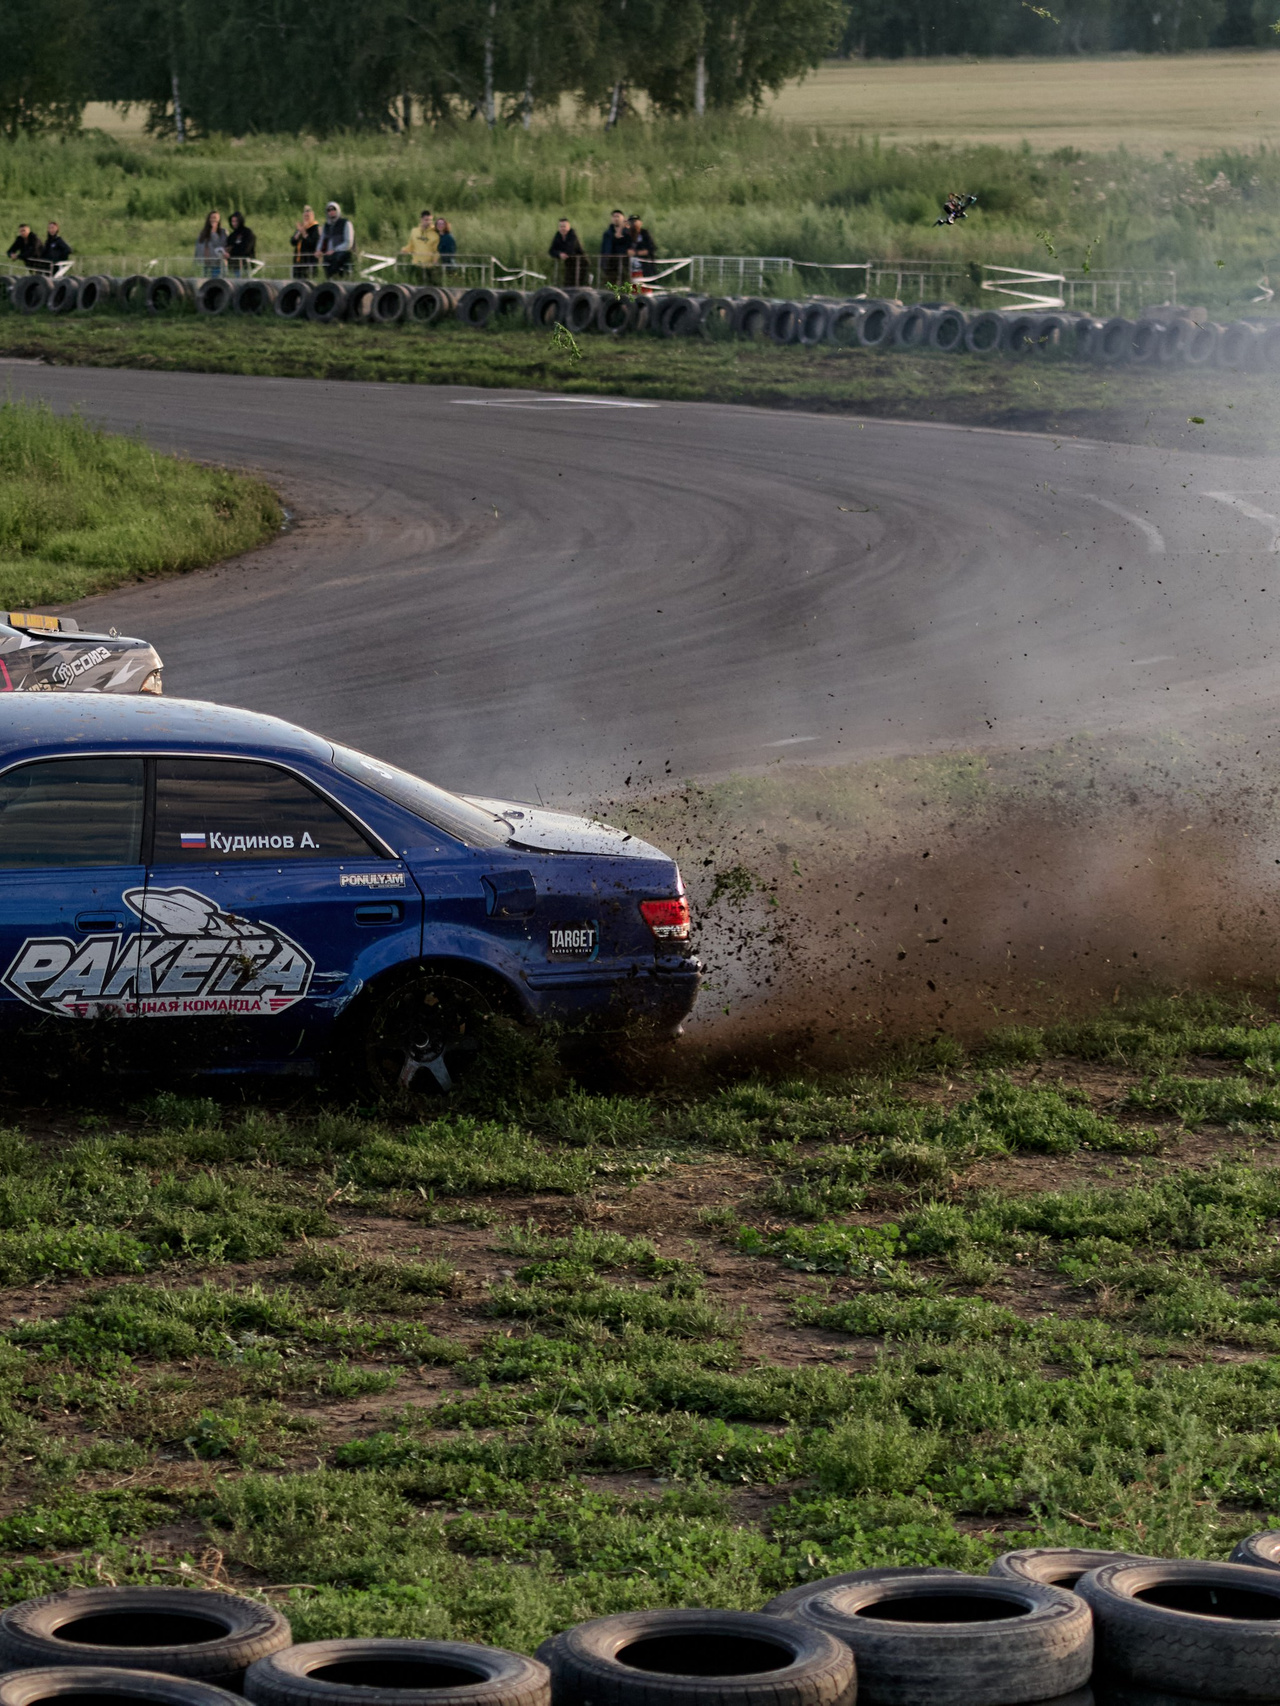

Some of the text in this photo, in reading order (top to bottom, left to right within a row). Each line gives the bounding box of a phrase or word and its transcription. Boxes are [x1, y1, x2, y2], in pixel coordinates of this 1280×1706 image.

[70, 646, 111, 676] СОЮЗ
[209, 832, 320, 853] Кудинов А.
[340, 873, 405, 887] PONULYAM
[550, 930, 595, 947] TARGET
[8, 937, 309, 999] РАКЕТА
[182, 1000, 261, 1014] КОМАНДА
